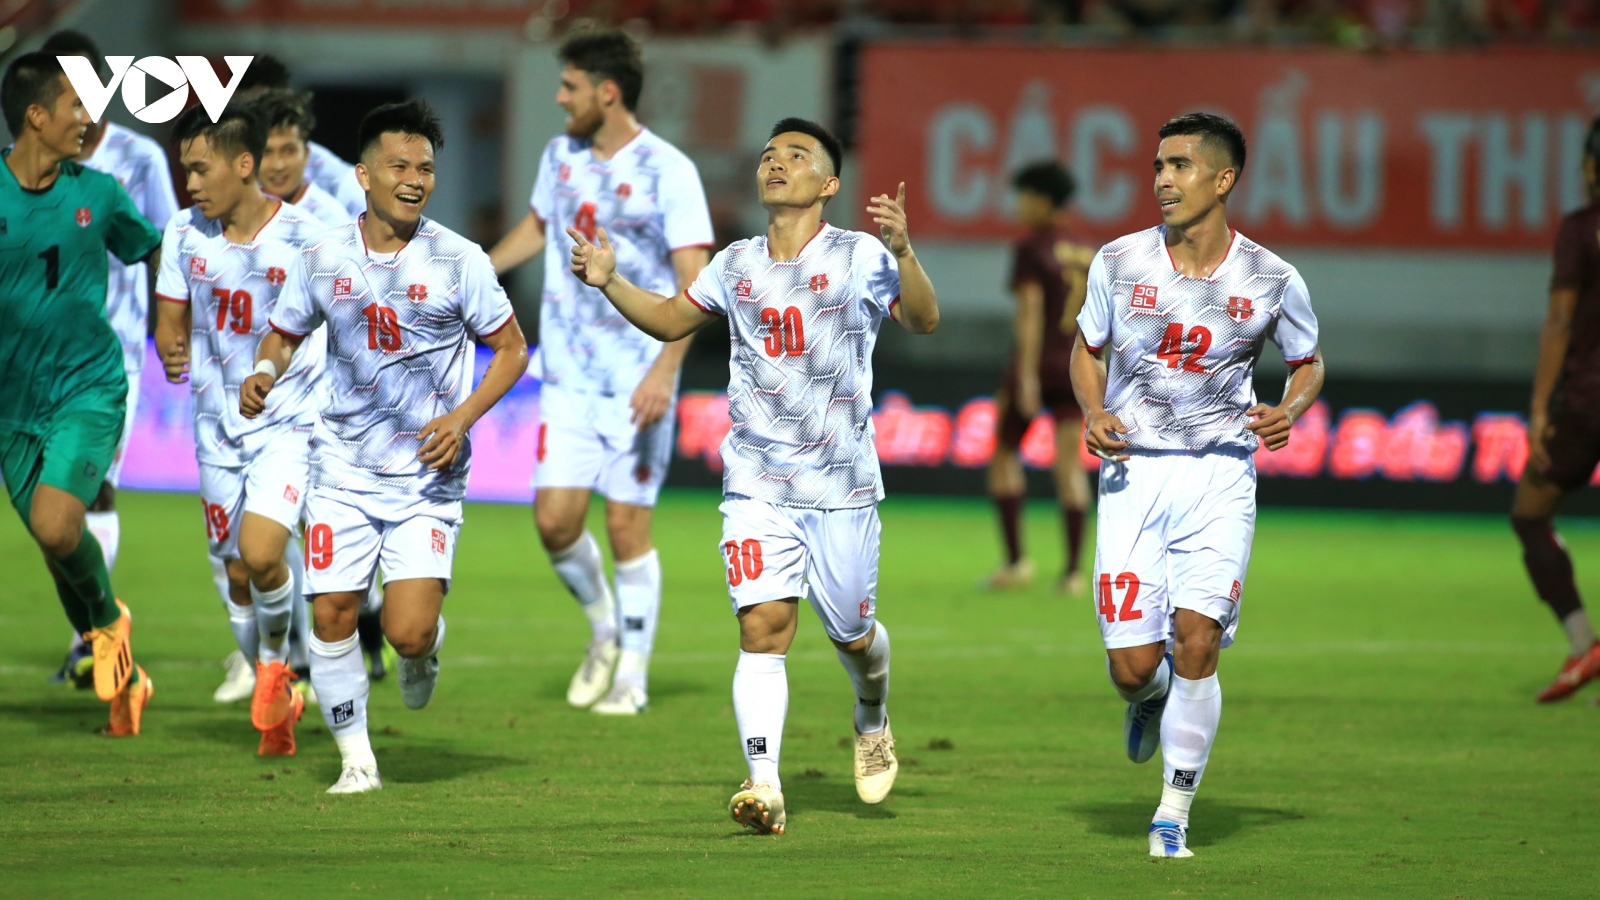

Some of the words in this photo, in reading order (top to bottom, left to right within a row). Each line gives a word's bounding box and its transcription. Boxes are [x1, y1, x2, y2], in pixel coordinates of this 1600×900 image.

[929, 80, 1136, 218] CÁC
[38, 244, 59, 290] 1
[1134, 286, 1156, 297] JG
[212, 288, 252, 335] 79
[362, 302, 402, 352] 19
[760, 306, 804, 357] 30
[1157, 323, 1212, 373] 42
[725, 538, 763, 587] 30
[1100, 572, 1142, 623] 42
